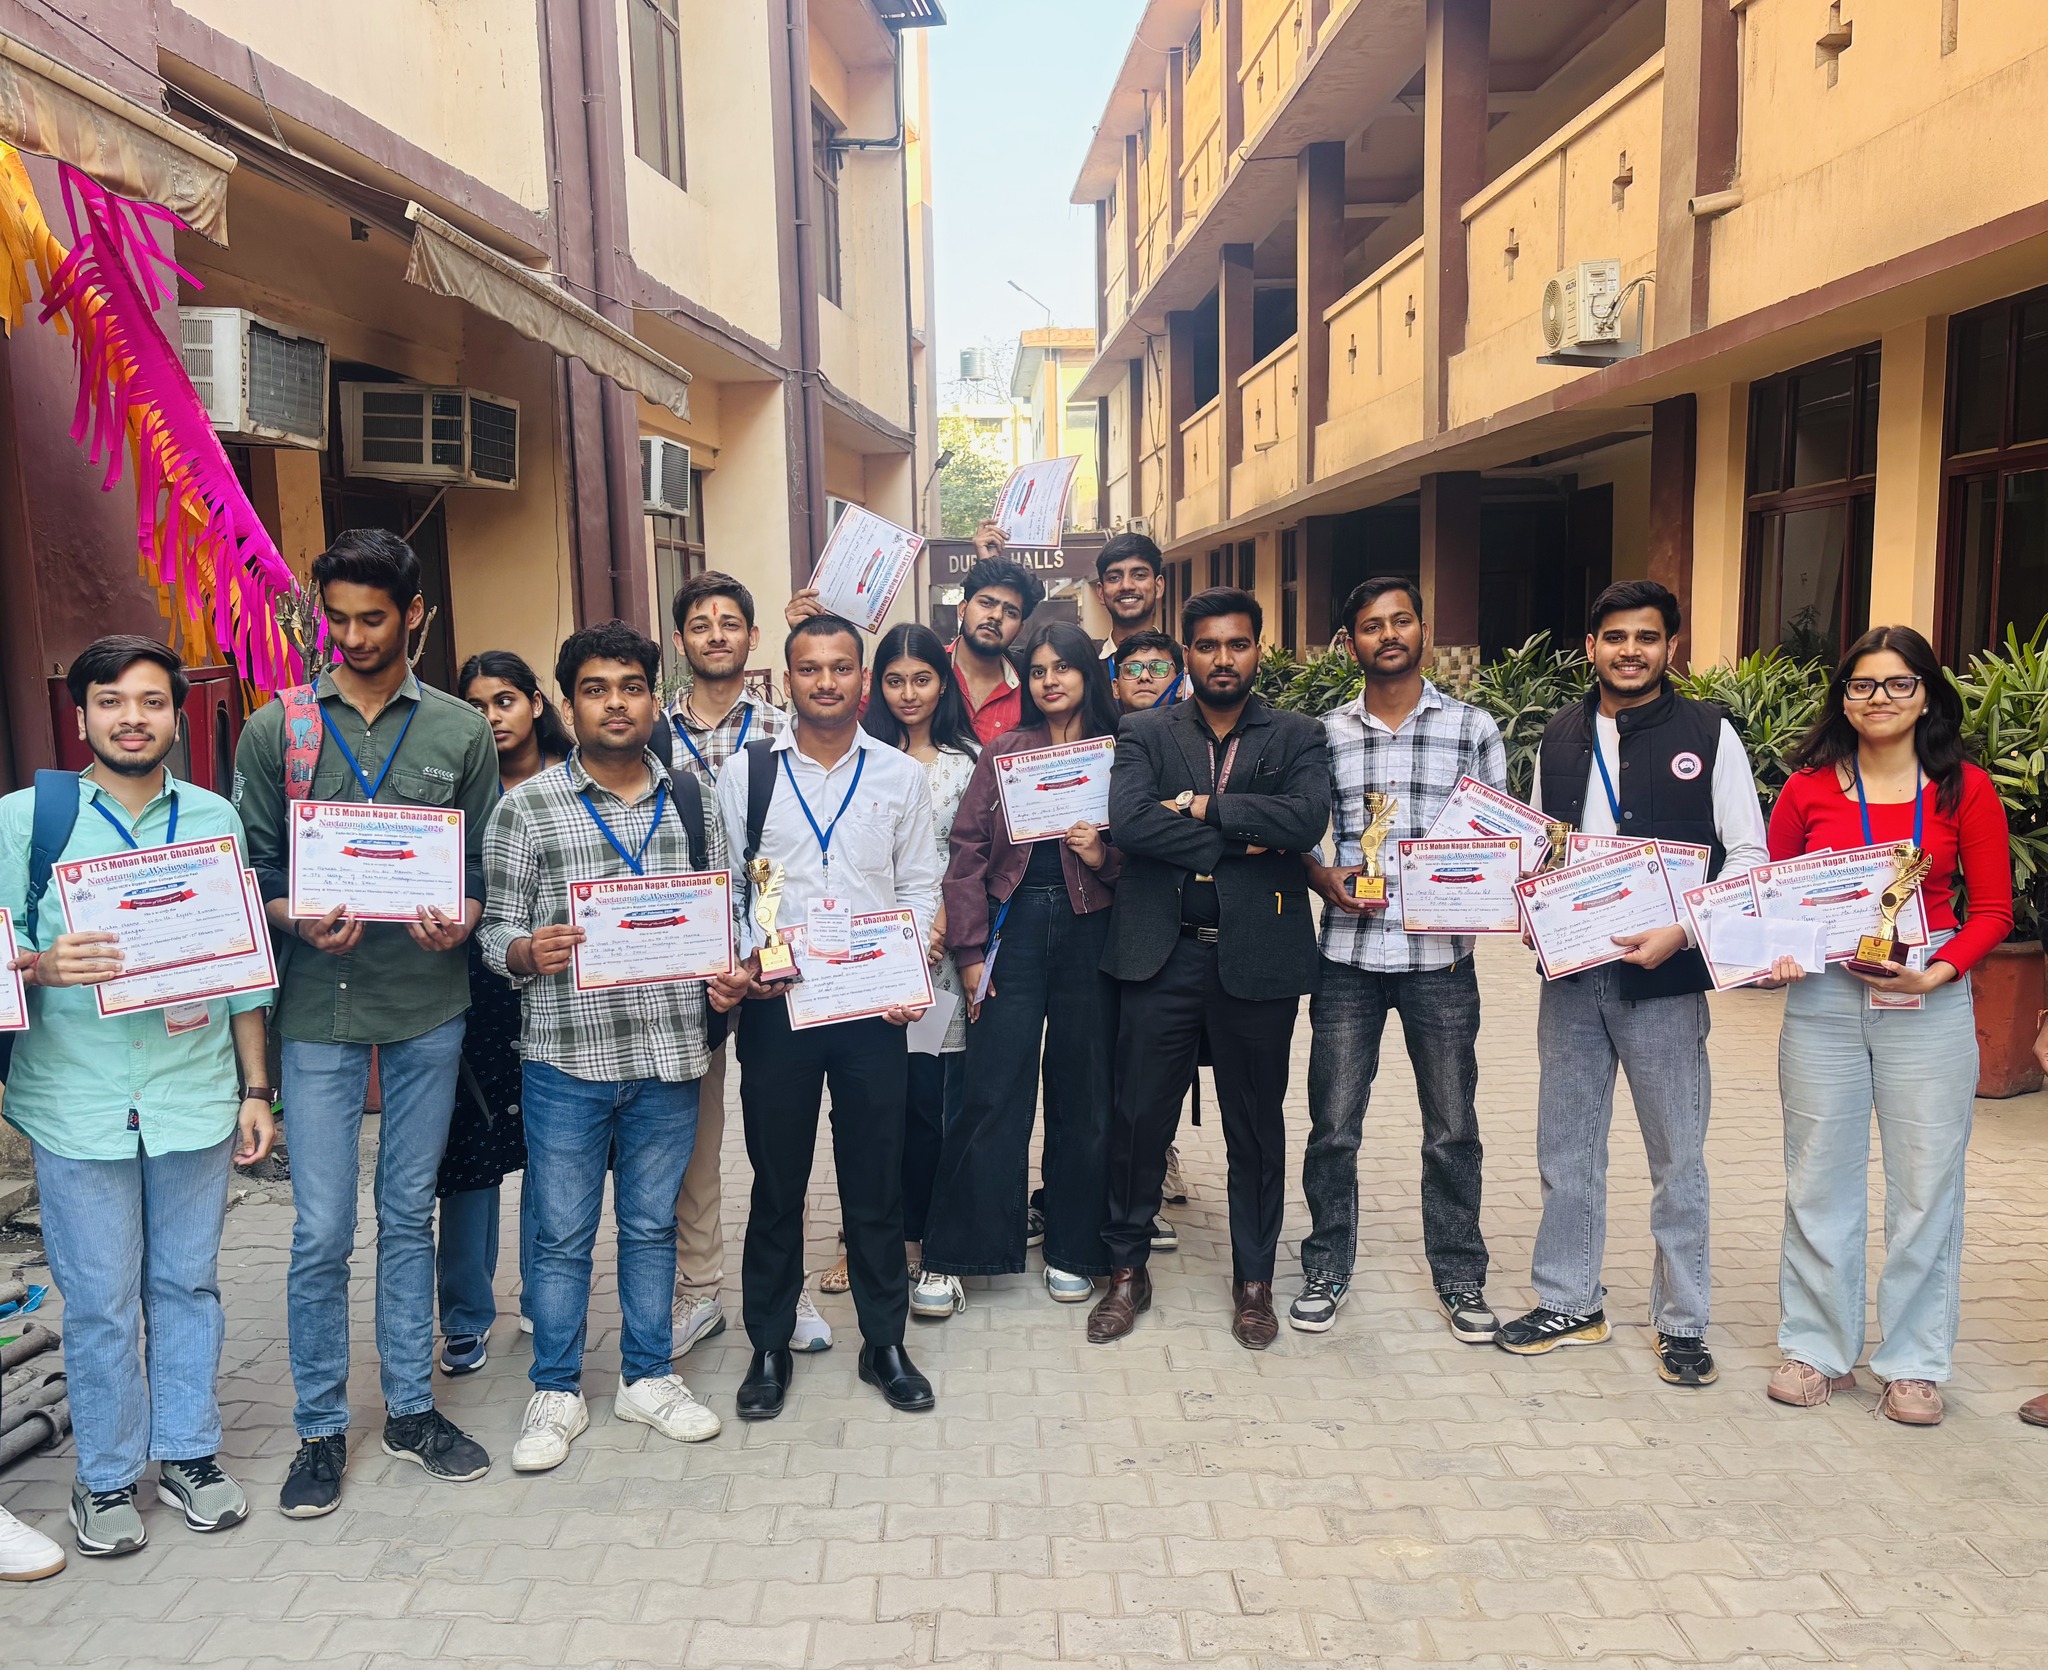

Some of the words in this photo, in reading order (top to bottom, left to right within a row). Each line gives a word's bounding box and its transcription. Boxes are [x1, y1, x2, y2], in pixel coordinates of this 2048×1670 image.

[1010, 550, 1064, 570] HALLS
[1017, 755, 1029, 763] I.T.S
[1030, 751, 1050, 761] Mohan
[1051, 747, 1070, 758] Nagar,
[1071, 741, 1102, 753] Ghaziabad
[1471, 784, 1483, 794] I.T.S
[1481, 790, 1498, 802] Mohan
[1497, 798, 1515, 811] Nagar,
[1514, 806, 1544, 825] Ghaziabad
[324, 807, 339, 816] I.T.S
[342, 808, 370, 817] Mohan
[373, 809, 398, 820] Nagar,
[401, 811, 442, 821] Ghaziabad
[318, 819, 364, 830] Navtarang
[422, 824, 443, 832] 2026
[1416, 842, 1428, 850] I.T.S
[1452, 841, 1471, 850] Nagar,
[1473, 840, 1505, 848] Ghaziabad
[1595, 839, 1609, 847] I.T.S
[1660, 845, 1695, 856] Ghaziabad
[89, 861, 107, 873] I.T.S
[108, 856, 139, 869] Mohan
[140, 851, 169, 865] Nagar,
[170, 843, 215, 859] Ghaziabad
[1414, 853, 1447, 861] Navtarang
[1777, 864, 1793, 874] I.T.S
[1795, 859, 1821, 871] Mohan
[1823, 855, 1849, 867] Nagar,
[1850, 848, 1891, 862] Ghaziabad
[86, 869, 136, 887] Navtarang
[136, 868, 147, 876] &
[147, 861, 188, 877] Wysiwyg
[196, 855, 219, 866] 2026
[1540, 875, 1556, 886] I.T.S
[1556, 867, 1581, 881] Mohan
[1582, 859, 1605, 874] Nagar,
[1605, 848, 1641, 865] Ghaziabad
[1774, 871, 1819, 887] Navtarang
[1829, 863, 1865, 878] Wysiwyg
[1873, 859, 1894, 868] 2026
[599, 884, 614, 893] I.T.S
[616, 882, 643, 891] Mohan
[645, 879, 670, 890] Nagar,
[672, 876, 711, 887] Ghaziabad
[1540, 879, 1581, 899] Navtarang
[1580, 876, 1589, 884] &
[1627, 858, 1645, 869] 2026
[1708, 884, 1724, 895] I.T.S
[1724, 876, 1749, 890] Mohan
[595, 894, 639, 906] Navtarang
[649, 890, 684, 901] Wysiwyg
[1708, 889, 1749, 907] Navtarang
[863, 913, 898, 925] Ghaziabad
[883, 923, 901, 932] 2026
